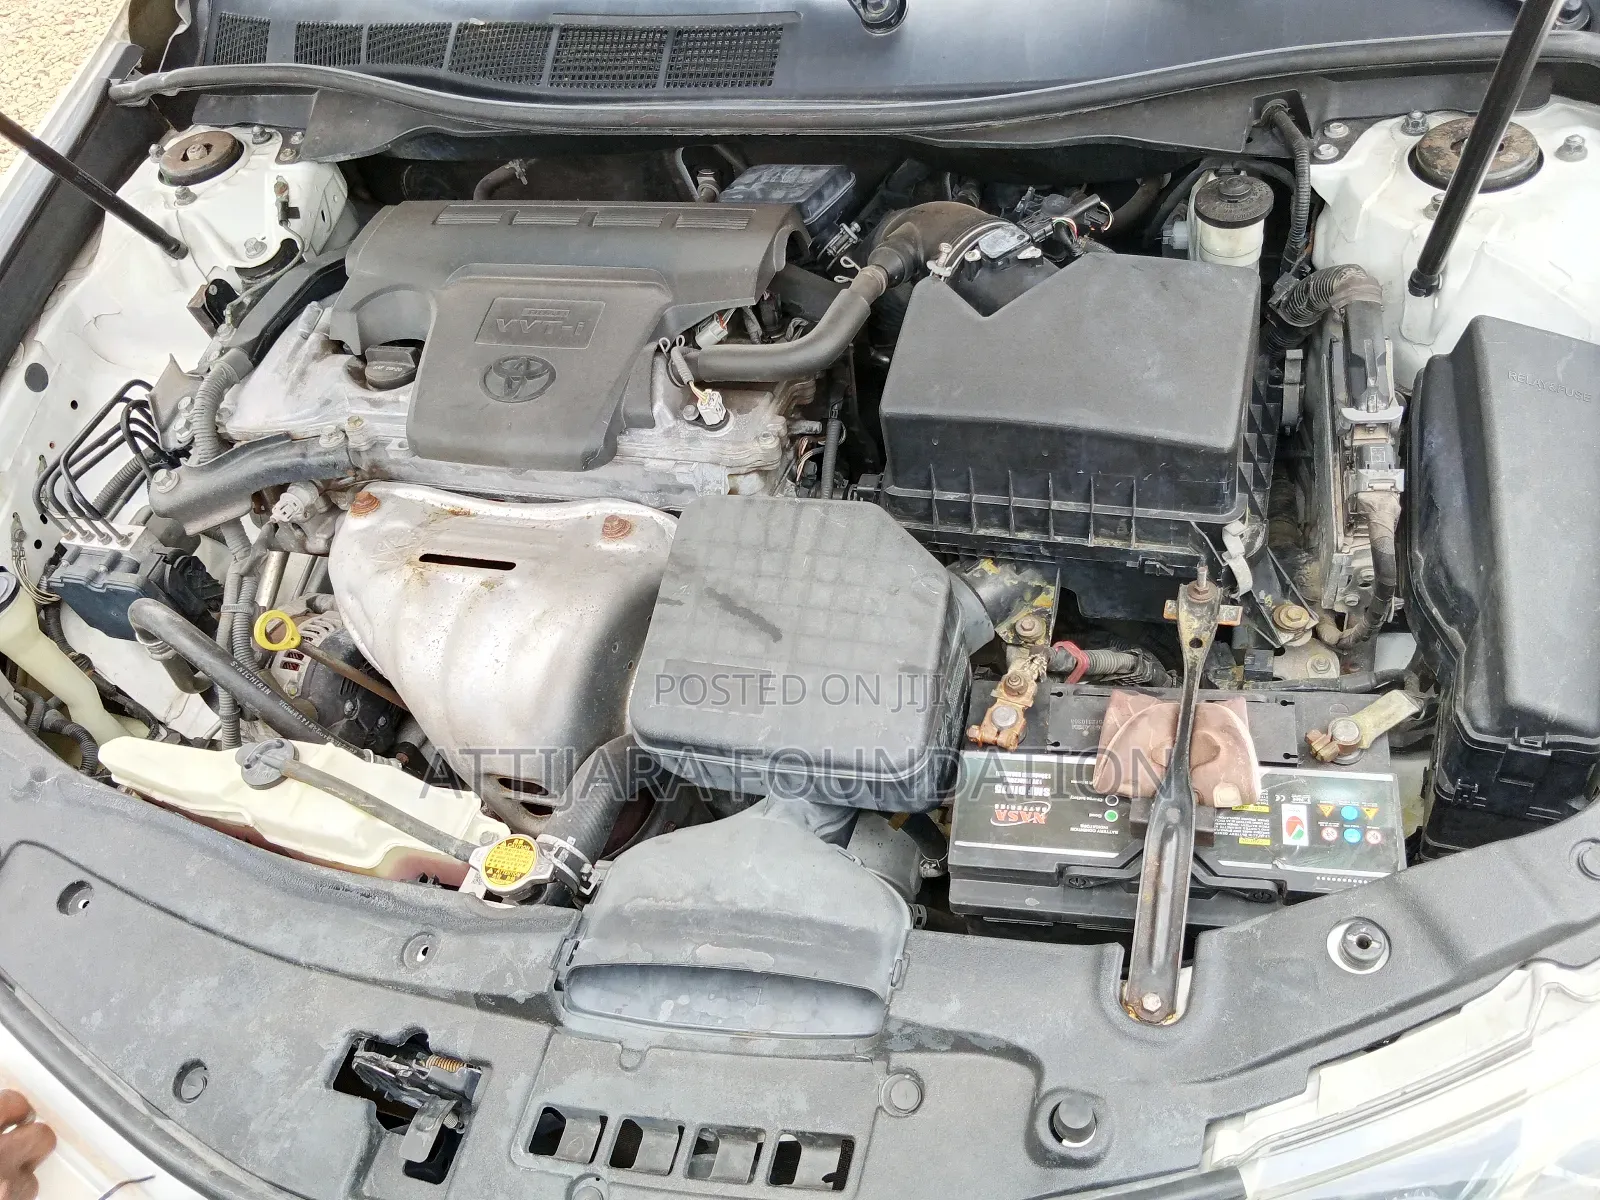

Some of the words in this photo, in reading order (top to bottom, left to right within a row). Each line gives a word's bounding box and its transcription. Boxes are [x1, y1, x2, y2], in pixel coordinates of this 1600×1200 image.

[496, 317, 585, 336] VVT-i
[994, 804, 1048, 812] BATTERIES
[995, 810, 1046, 824] NASA
